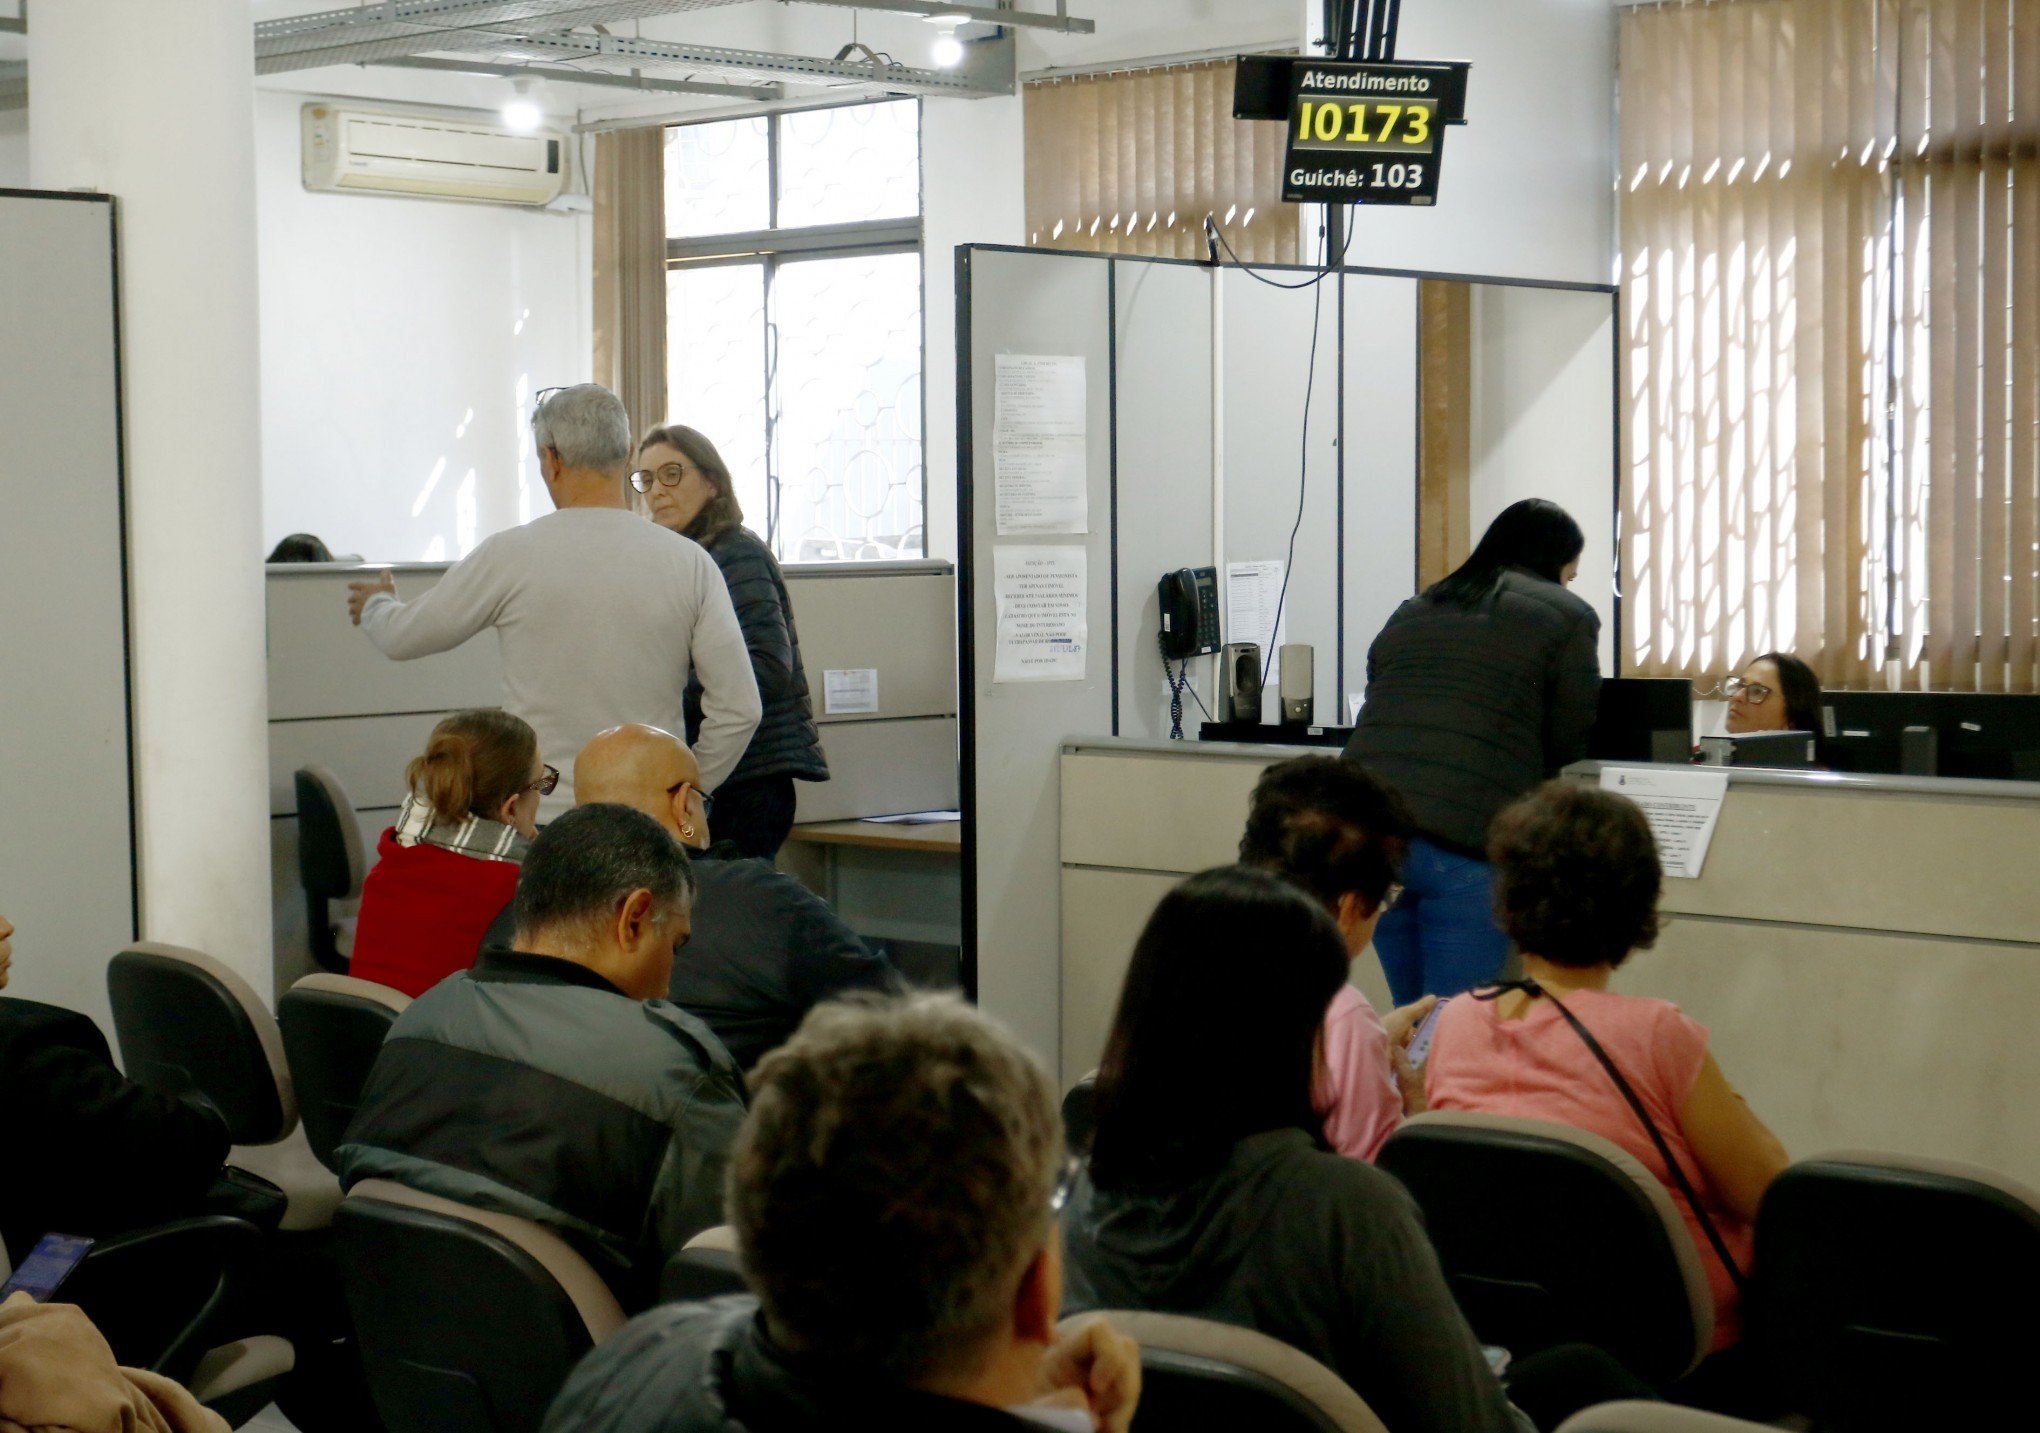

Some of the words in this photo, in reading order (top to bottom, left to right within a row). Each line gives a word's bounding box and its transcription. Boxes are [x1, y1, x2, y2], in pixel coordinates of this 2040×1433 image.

[1301, 70, 1430, 92] Atendimento
[1299, 102, 1430, 144] I0173
[1290, 168, 1364, 187] Guichê:
[1370, 163, 1424, 188] 103
